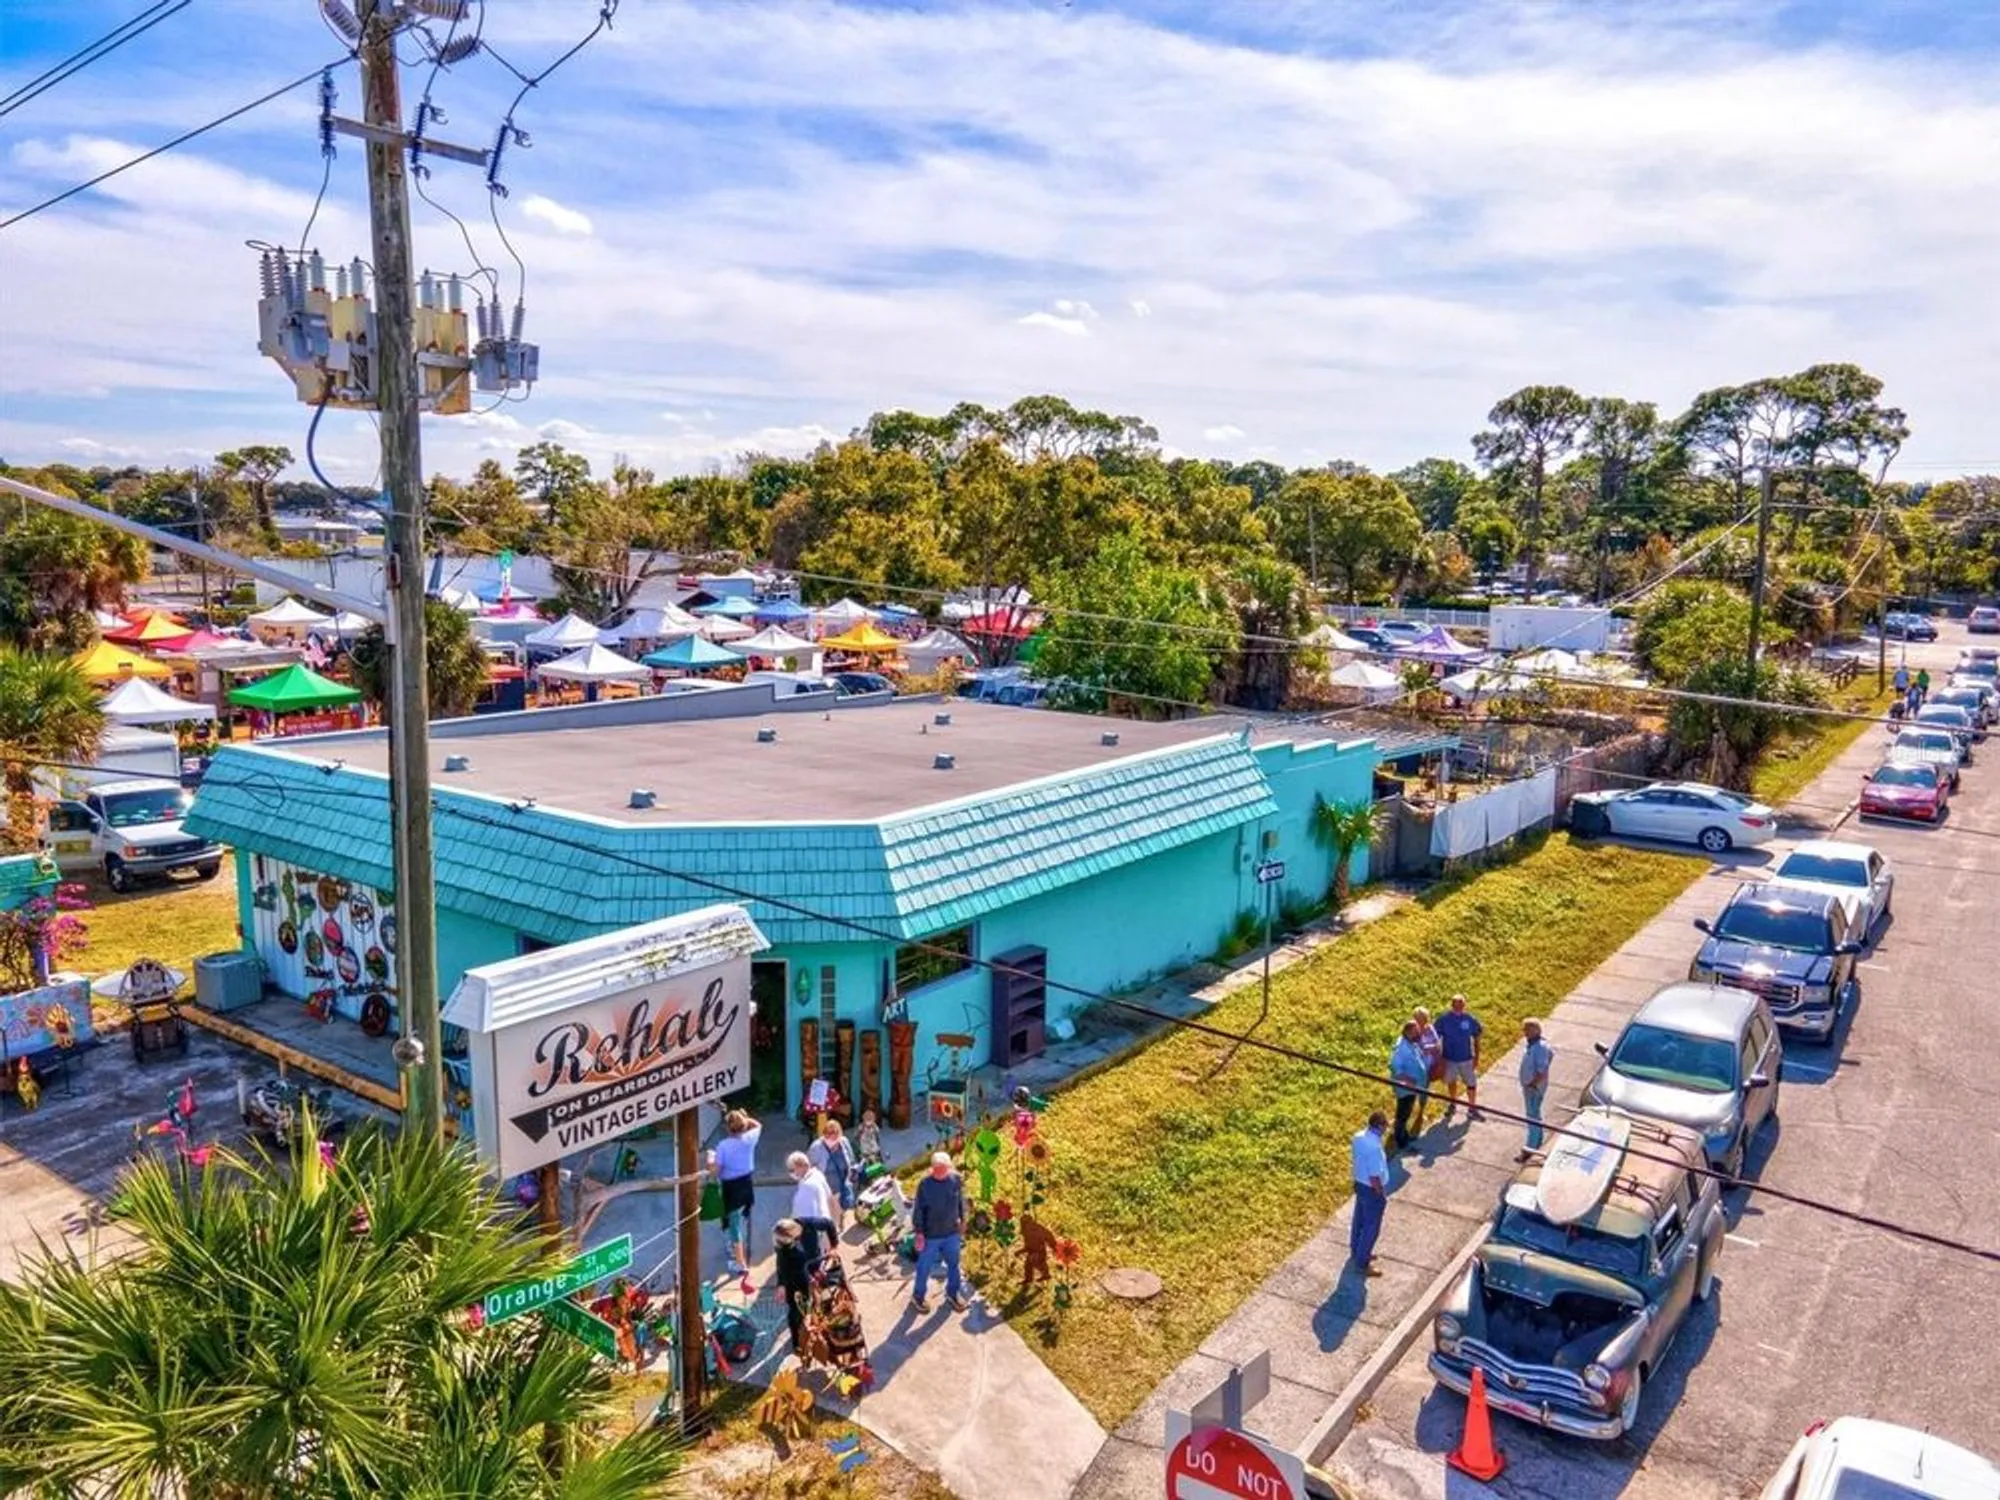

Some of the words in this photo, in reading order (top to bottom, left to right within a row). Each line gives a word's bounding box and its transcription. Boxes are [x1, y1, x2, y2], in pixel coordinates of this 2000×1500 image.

[527, 977, 739, 1097] Rehab
[882, 998, 905, 1023] ART
[553, 1100, 583, 1118] ON
[588, 1063, 685, 1106] DEARBORN
[558, 1099, 648, 1148] VINTAGE
[654, 1066, 738, 1112] GALLERY
[489, 1273, 568, 1316] Orange
[585, 1254, 596, 1269] St
[575, 1263, 608, 1286] South
[1186, 1446, 1216, 1475] DO
[1237, 1465, 1282, 1500] NOT
